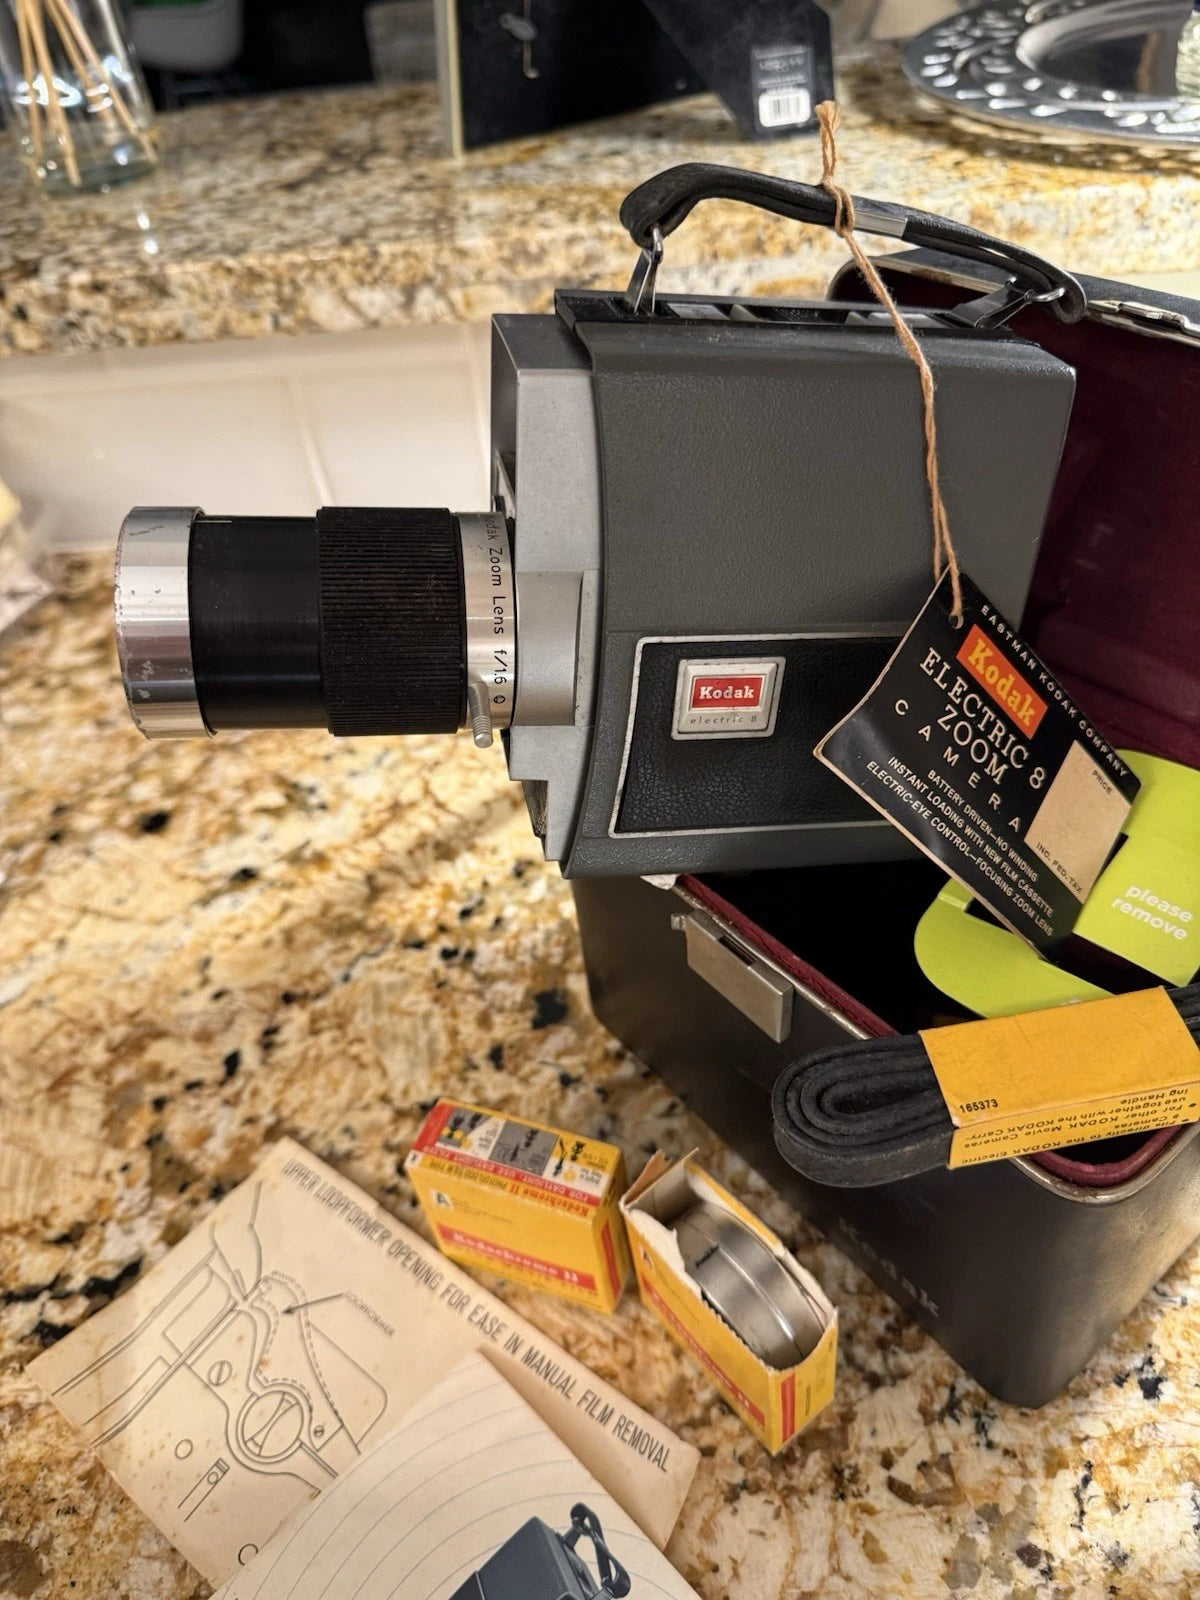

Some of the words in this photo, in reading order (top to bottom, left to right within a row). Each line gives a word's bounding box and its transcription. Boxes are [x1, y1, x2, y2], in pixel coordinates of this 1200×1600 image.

[489, 547, 503, 586] Zoom
[493, 596, 506, 634] Lens
[493, 649, 508, 684] f/1.6
[967, 638, 1035, 727] Kodak
[699, 685, 754, 700] Kodak
[981, 605, 1036, 671] EASTMAN
[1039, 672, 1077, 718] KODAK
[1079, 720, 1129, 777] COMPANY
[690, 716, 743, 724] electric
[751, 715, 757, 723] 8
[919, 647, 1028, 769] ELECTRIC
[1029, 766, 1046, 789] 8
[937, 704, 1009, 785] ZOOM
[895, 699, 1021, 832] CAMERA
[1092, 769, 1112, 795] PRICE
[927, 770, 965, 807] BATTERY
[1007, 848, 1038, 882] WINDING
[888, 756, 929, 794] INSTANT
[926, 791, 965, 829] LOADING
[963, 824, 984, 848] WITH
[983, 842, 1002, 865] NEW
[1000, 860, 1021, 883] FILM
[1017, 879, 1054, 918] CASSETTE
[866, 760, 933, 820] ELECTRIC-EYE
[1012, 892, 1035, 918] ZOOM
[1034, 915, 1053, 936] LENS
[1125, 885, 1193, 922] please
[1111, 897, 1188, 940] remove
[1120, 1093, 1165, 1104] Handle
[1169, 1088, 1188, 1096] ing
[959, 1098, 998, 1113] 165373
[1108, 1101, 1161, 1114] together
[1165, 1096, 1186, 1104] use
[1080, 1110, 1106, 1119] with
[1124, 1109, 1158, 1119] other
[1163, 1104, 1183, 1112] For
[1007, 1119, 1054, 1133] KODAK
[1069, 1116, 1119, 1129] KODAK
[1114, 1116, 1168, 1129] Cameras
[1025, 1126, 1062, 1135] Movie
[964, 1133, 1018, 1148] Cameras
[1013, 1141, 1061, 1154] KODAK
[281, 1158, 321, 1192] UPPER
[313, 1182, 392, 1249] LOOPFORMER
[387, 1238, 444, 1290] OPENING
[439, 1282, 471, 1315] FOR
[467, 1304, 508, 1341] EASE
[502, 1332, 524, 1356] IN
[521, 1345, 579, 1400] MANUAL
[576, 1388, 615, 1427] FILM
[611, 1415, 670, 1473] REMOVAL
